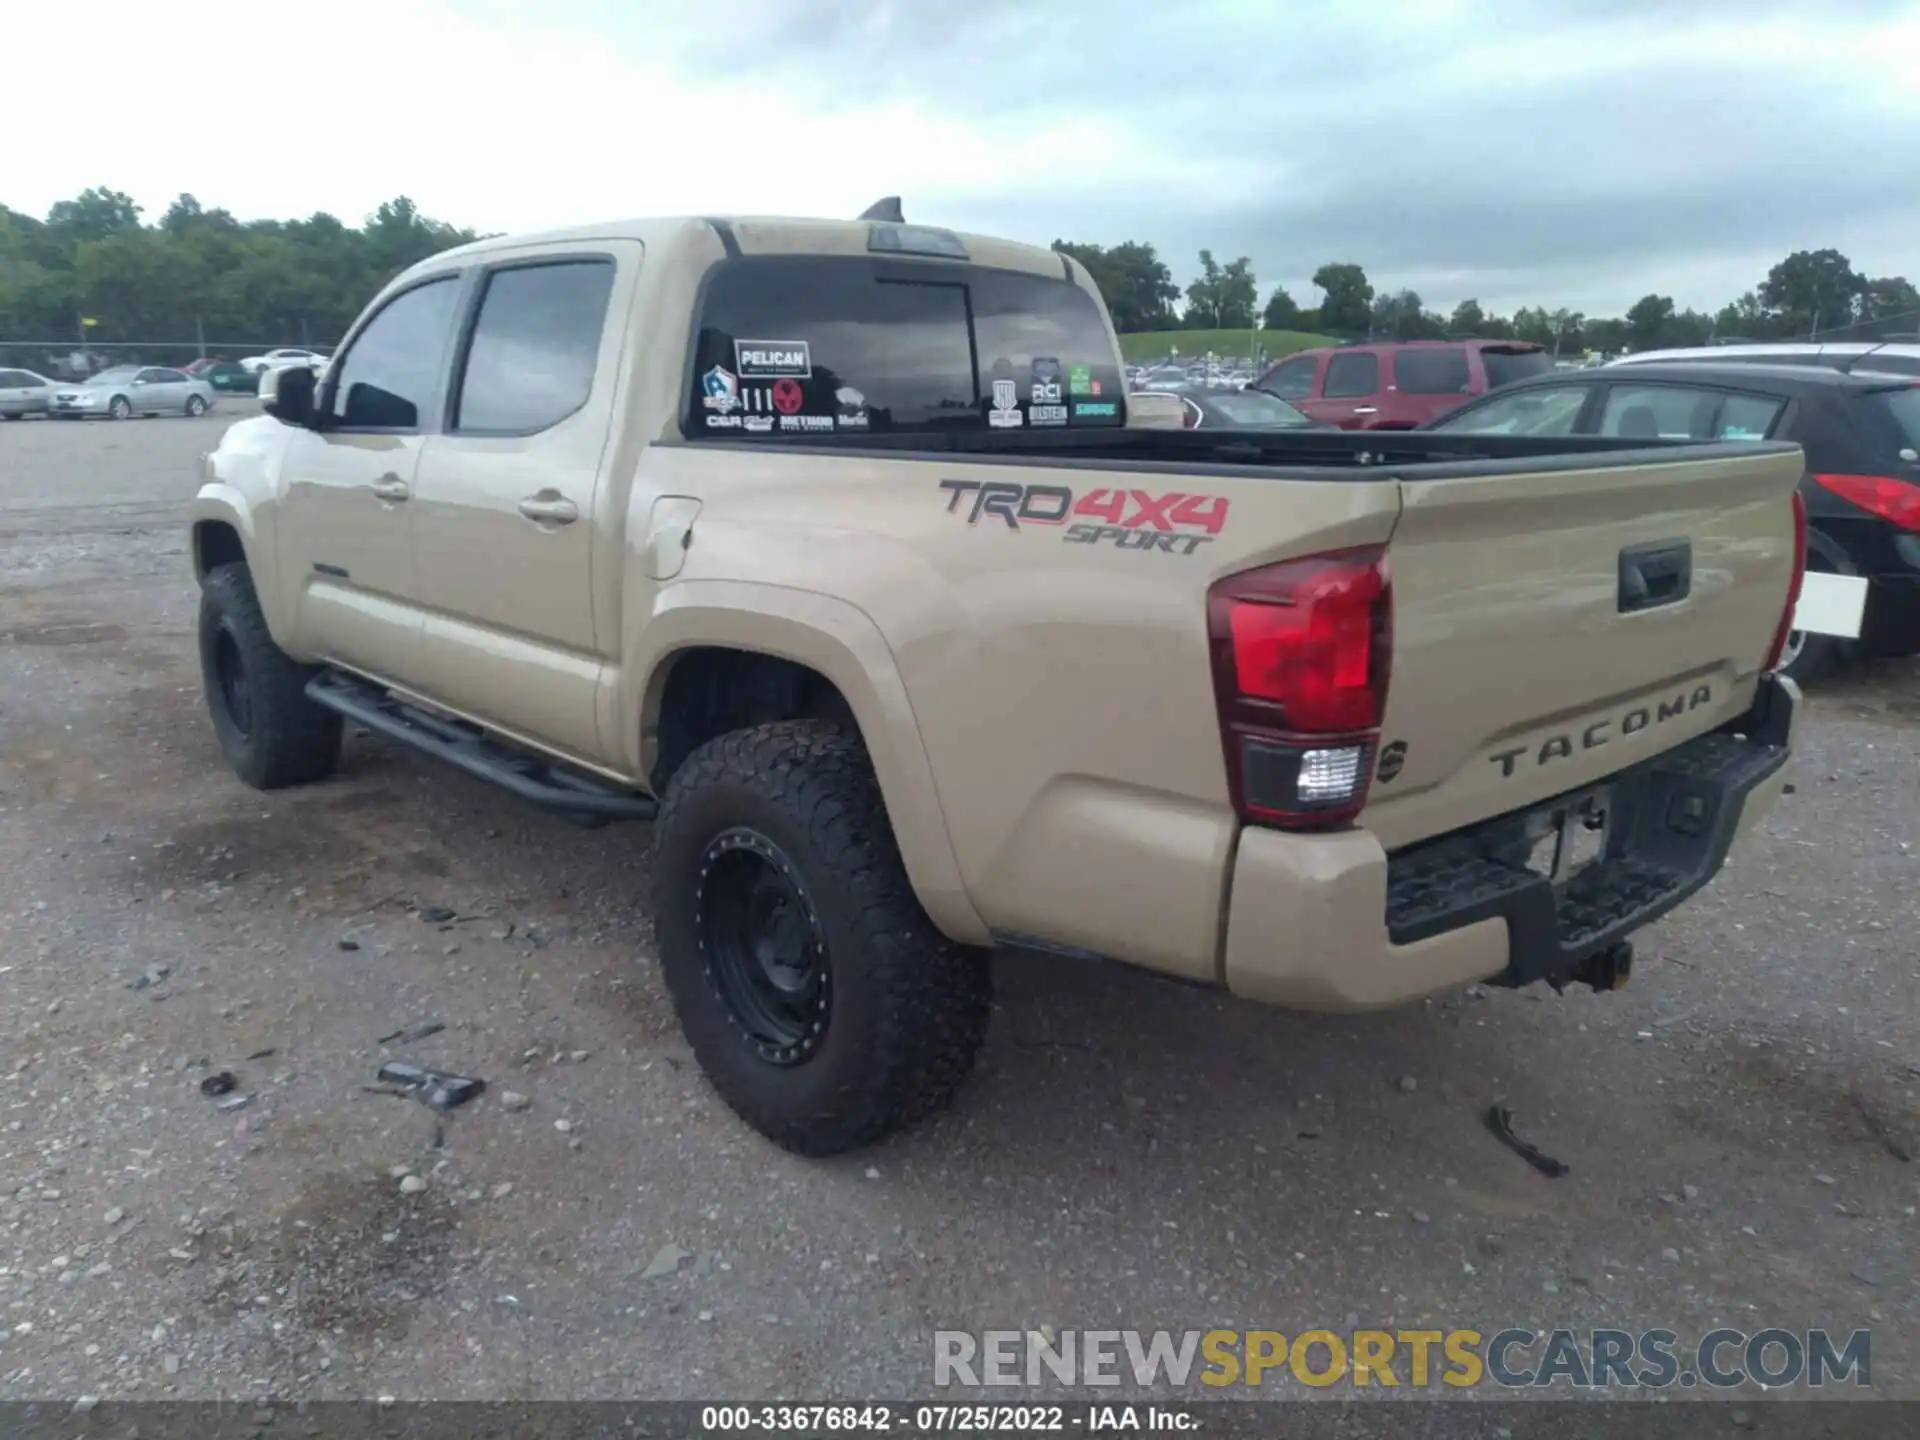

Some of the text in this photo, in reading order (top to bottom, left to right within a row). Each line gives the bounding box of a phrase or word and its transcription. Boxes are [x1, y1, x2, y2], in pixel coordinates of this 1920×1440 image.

[741, 351, 804, 366] PELICAN
[1032, 384, 1061, 399] RCI
[939, 479, 1073, 533] TRD
[1062, 523, 1214, 555] SPORT
[1489, 684, 1711, 777] TACOMA
